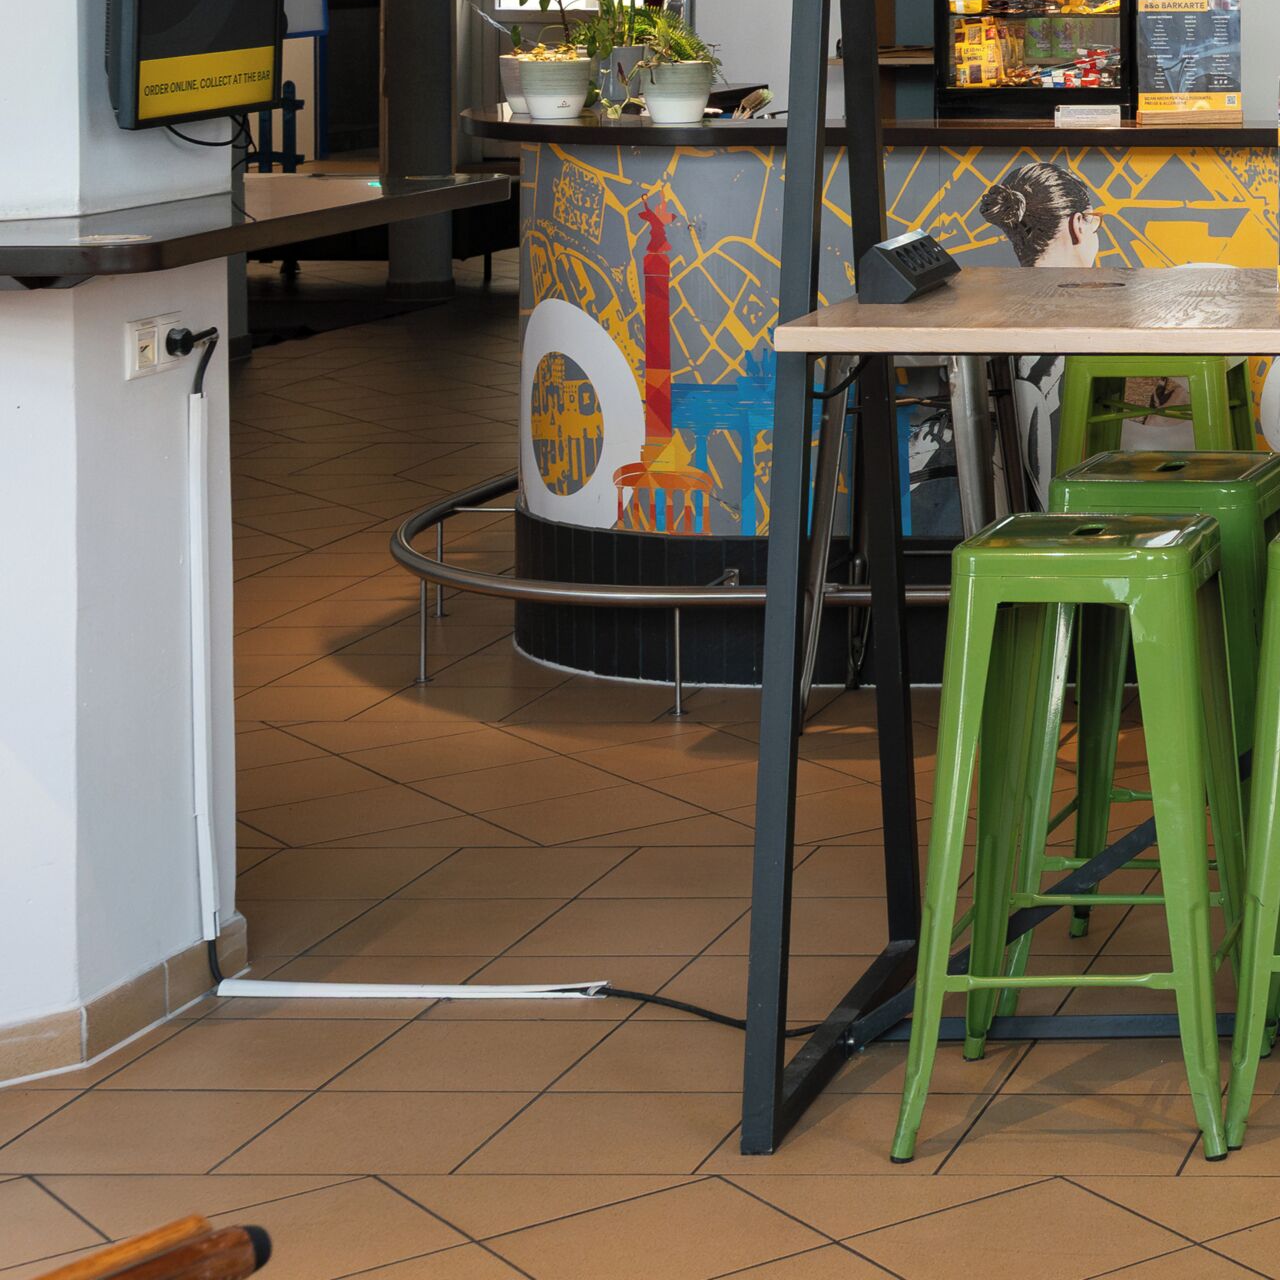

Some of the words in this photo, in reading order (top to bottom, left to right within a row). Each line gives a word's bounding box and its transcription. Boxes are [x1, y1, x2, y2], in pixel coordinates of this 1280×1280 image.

[1161, 2, 1205, 10] BARKARTE
[144, 83, 168, 96] ORDER
[170, 80, 199, 93] ONLINE,
[200, 75, 232, 89] COLLECT
[232, 74, 241, 84] AT
[244, 72, 256, 83] THE
[257, 70, 270, 81] BAR
